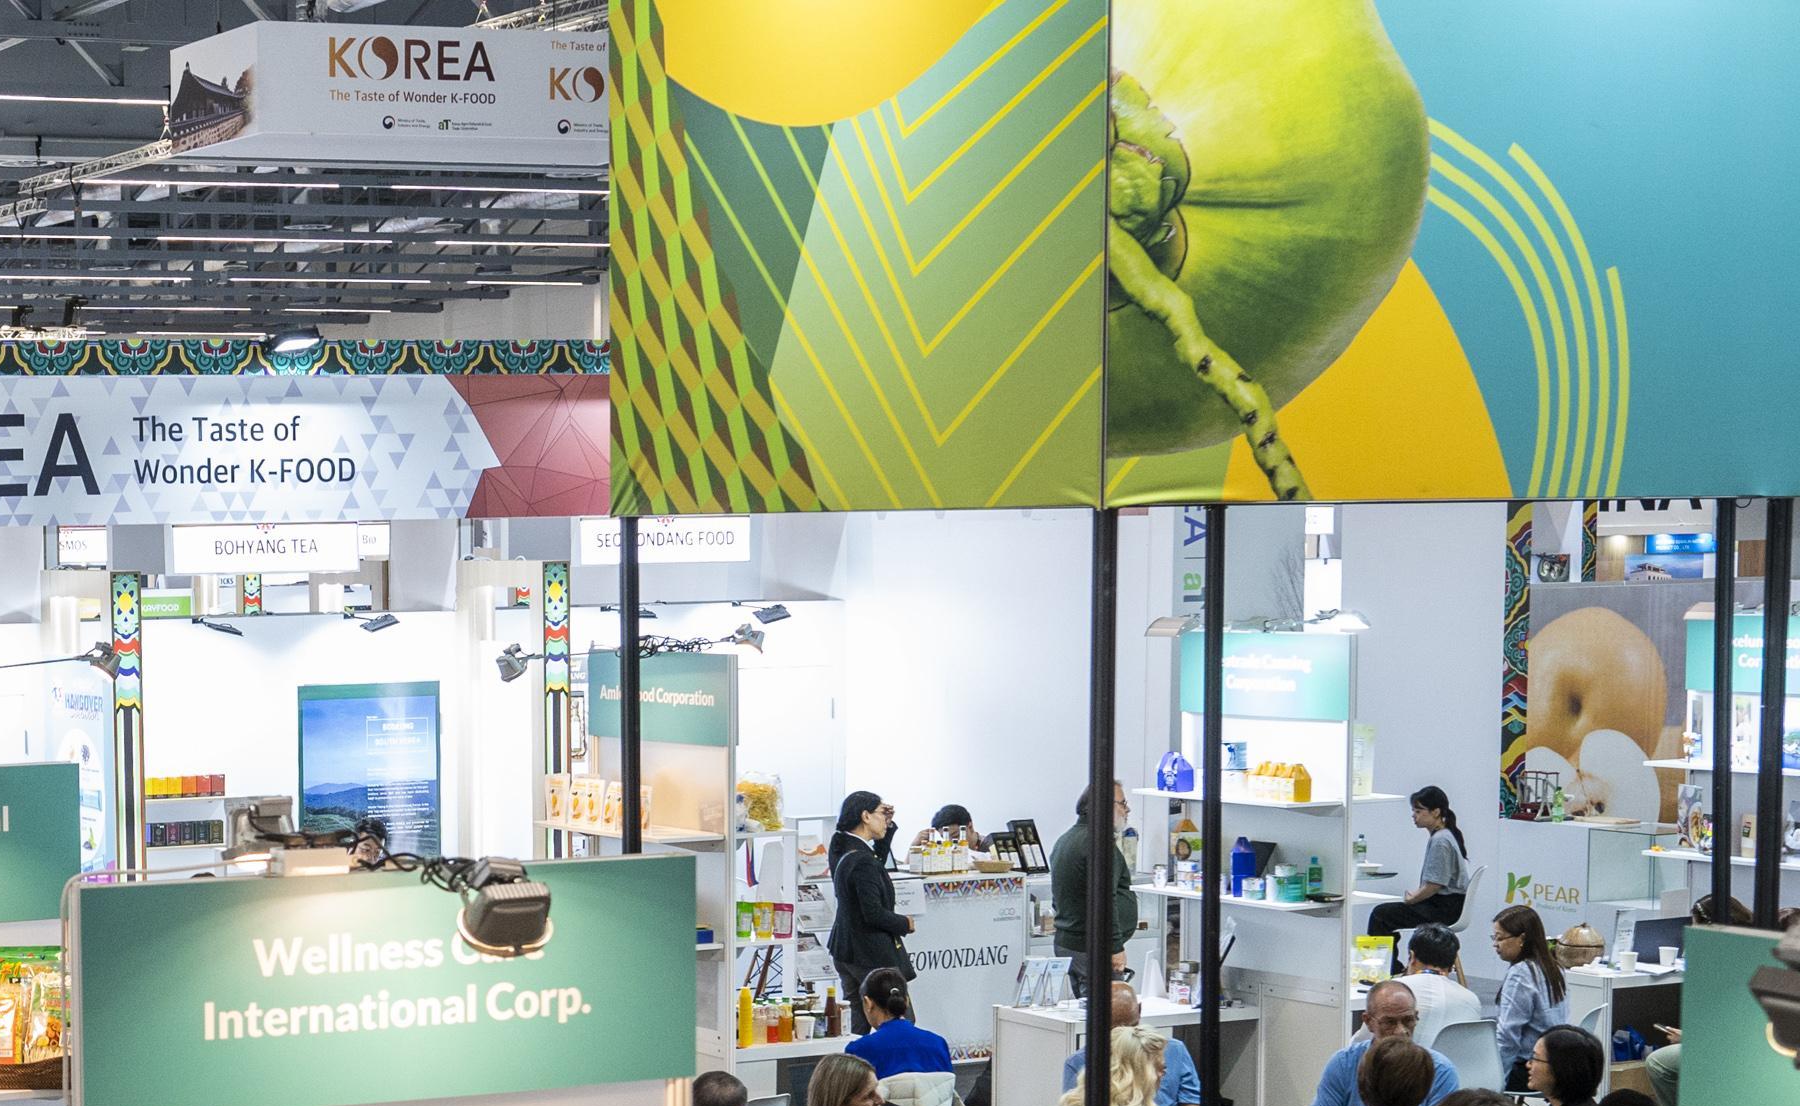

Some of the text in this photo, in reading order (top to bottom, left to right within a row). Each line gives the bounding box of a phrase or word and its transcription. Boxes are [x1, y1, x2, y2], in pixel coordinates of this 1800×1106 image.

[328, 36, 496, 82] KOREA
[329, 90, 497, 105] The Taste of Wonder K-FOOD
[133, 414, 301, 442] The Taste of
[134, 458, 357, 486] Wonder K-FOOD
[214, 538, 319, 556] BOHYANG TEA
[596, 530, 735, 548] SEOONDANG FOOD
[656, 687, 715, 707] Corporation
[1533, 883, 1580, 905] PEAR
[251, 934, 445, 978] Wellness
[204, 981, 593, 1041] International Corp.
